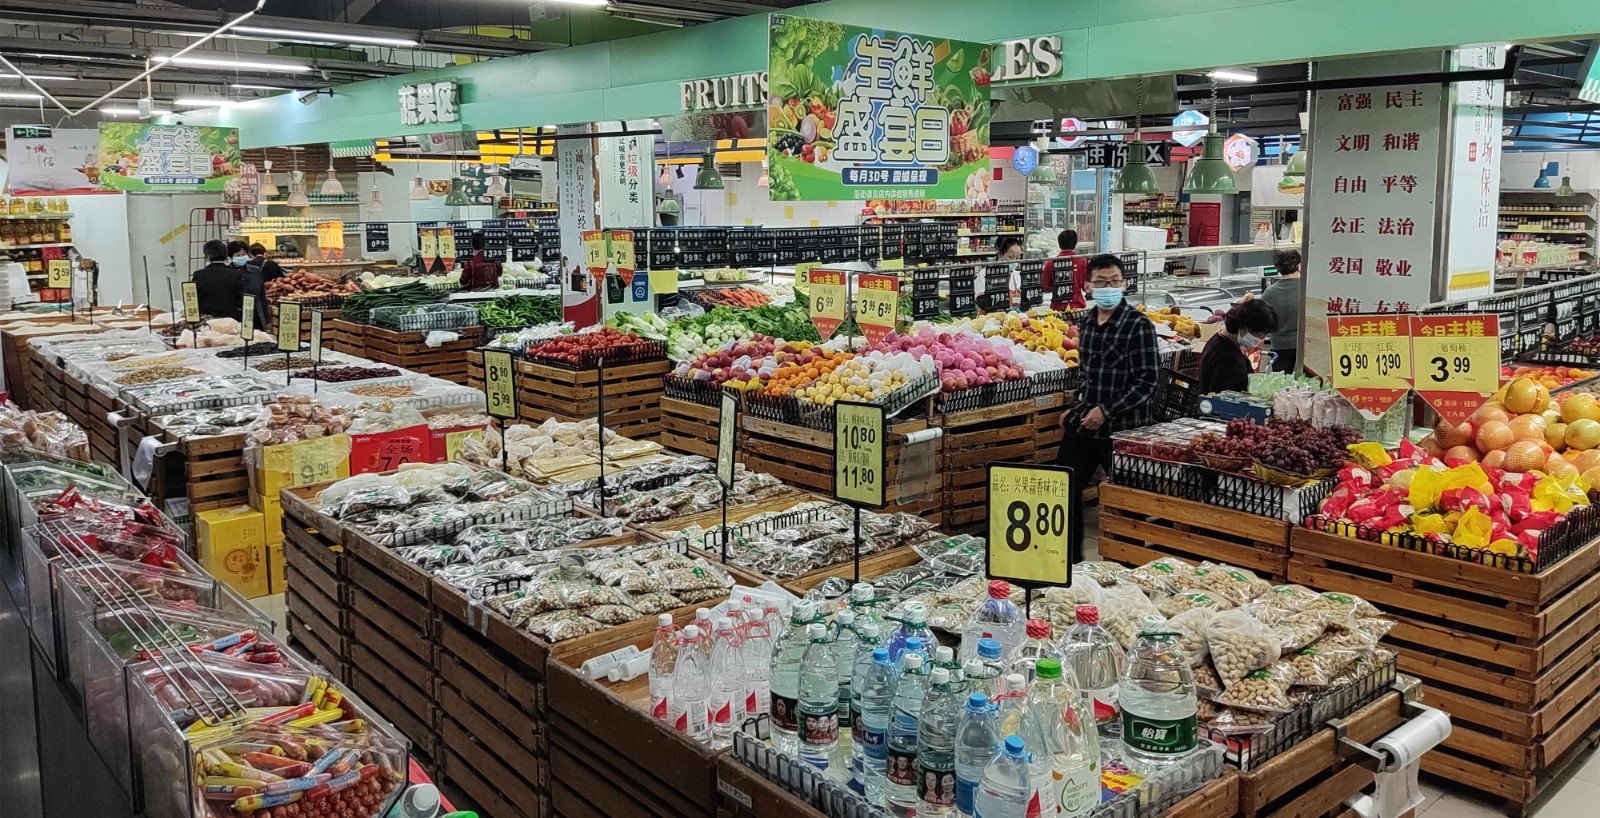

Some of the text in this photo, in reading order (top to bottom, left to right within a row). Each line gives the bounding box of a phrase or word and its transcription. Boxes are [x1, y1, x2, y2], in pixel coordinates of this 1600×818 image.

[855, 32, 935, 104] 生鲜
[399, 82, 459, 125] 蔬果区
[1337, 89, 1424, 111] 富强 民主
[149, 126, 201, 152] 生鲜
[830, 95, 949, 163] 盛宴日
[1335, 132, 1420, 152] 文明 和谐
[138, 152, 213, 176] 盛宴日
[627, 152, 639, 204] 垃圾分类
[1334, 175, 1417, 194] 自由 平等
[1330, 216, 1415, 236] 公正 法治
[1328, 257, 1412, 276] 爱国 敬业
[1326, 297, 1361, 313] 诚信
[1337, 320, 1397, 336] 今日主推
[1420, 319, 1485, 337] 今日主推
[489, 365, 508, 382] 8.90
[1339, 353, 1401, 377] 9.90 13.90
[1430, 356, 1470, 383] 3.99
[492, 392, 510, 407] 5.99
[842, 424, 876, 450] 10.80
[387, 443, 414, 455] 全场
[300, 462, 330, 485] 9.90
[842, 464, 874, 489] 11.80
[1014, 476, 1067, 498] 兴果蒜香味花生
[1005, 500, 1065, 552] 8.80
